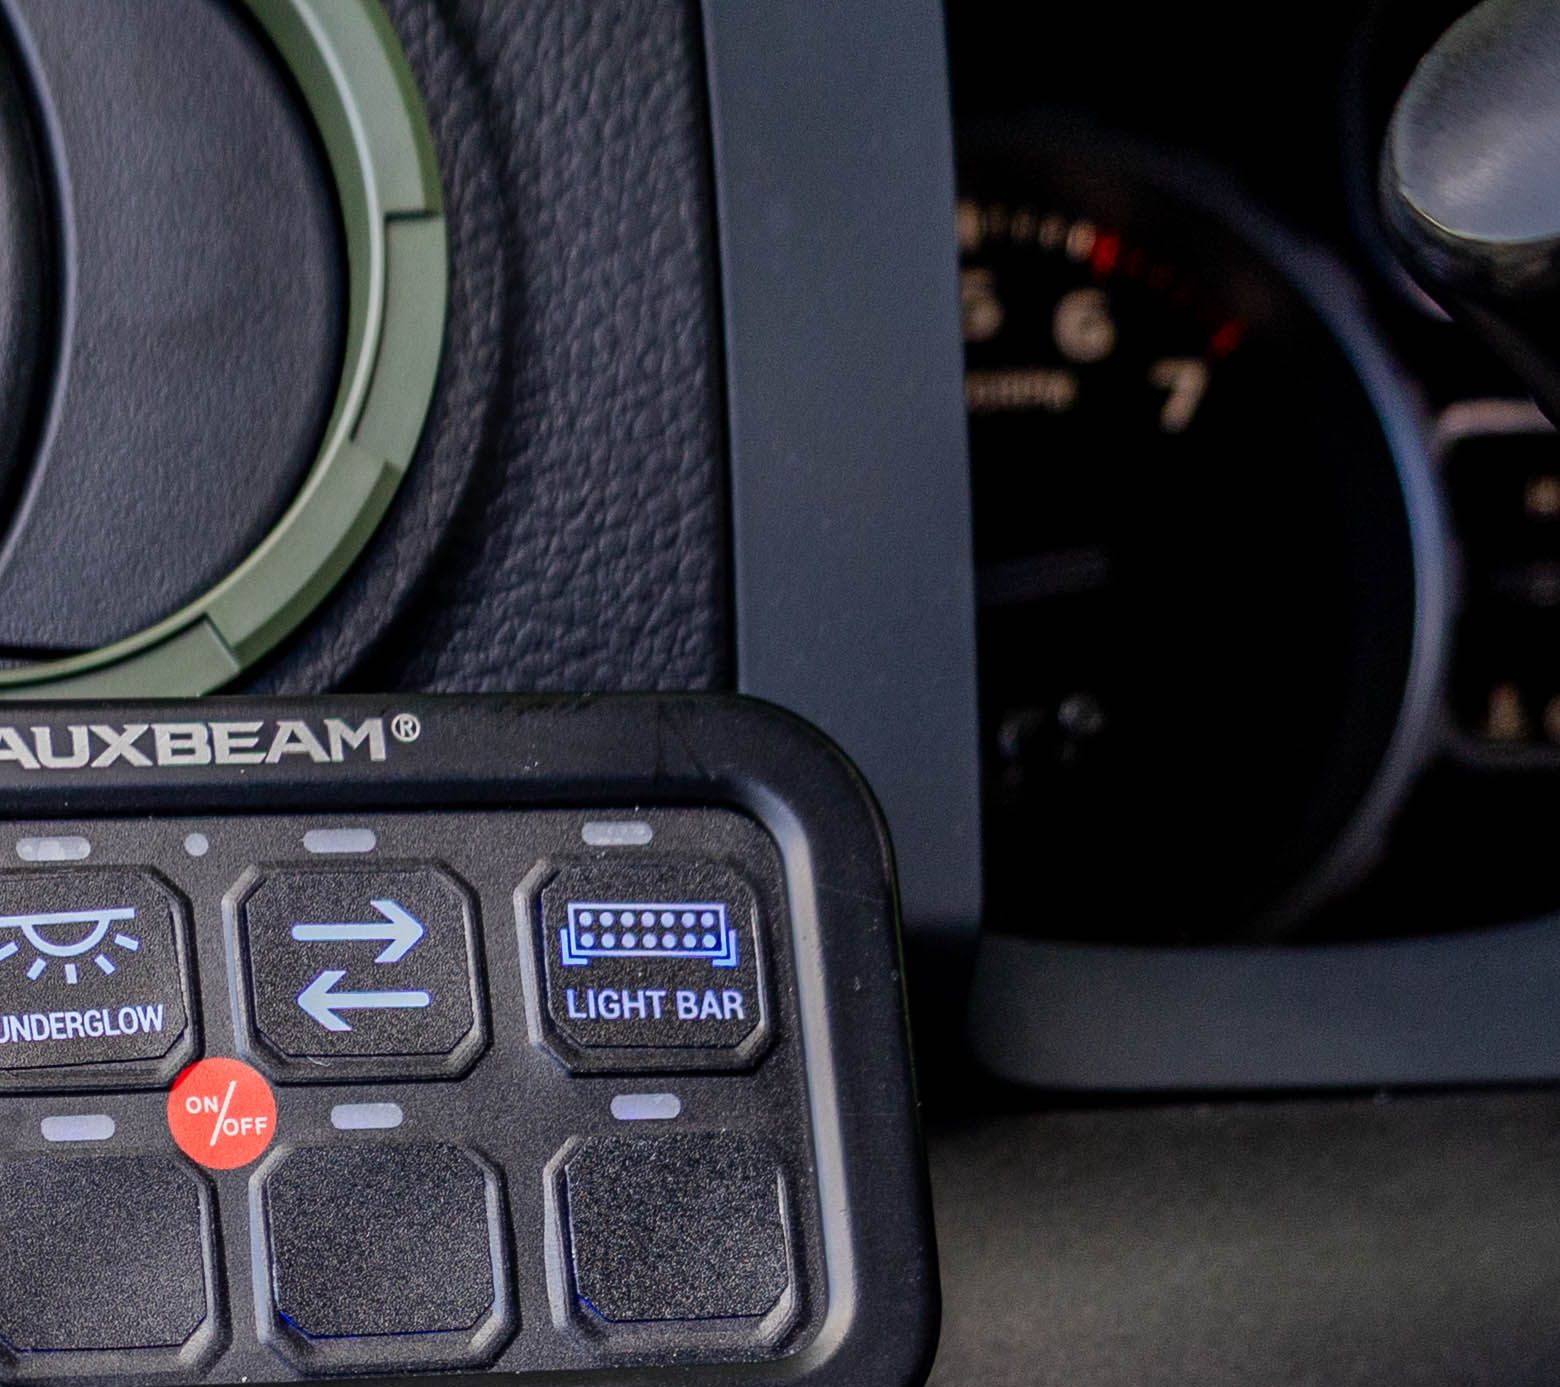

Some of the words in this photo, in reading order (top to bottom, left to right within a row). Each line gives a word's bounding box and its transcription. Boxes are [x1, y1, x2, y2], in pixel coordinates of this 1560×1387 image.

[1052, 288, 1117, 362] 6
[1148, 355, 1208, 433] 7
[566, 988, 666, 1021] LIGHT
[676, 988, 746, 1021] BAR
